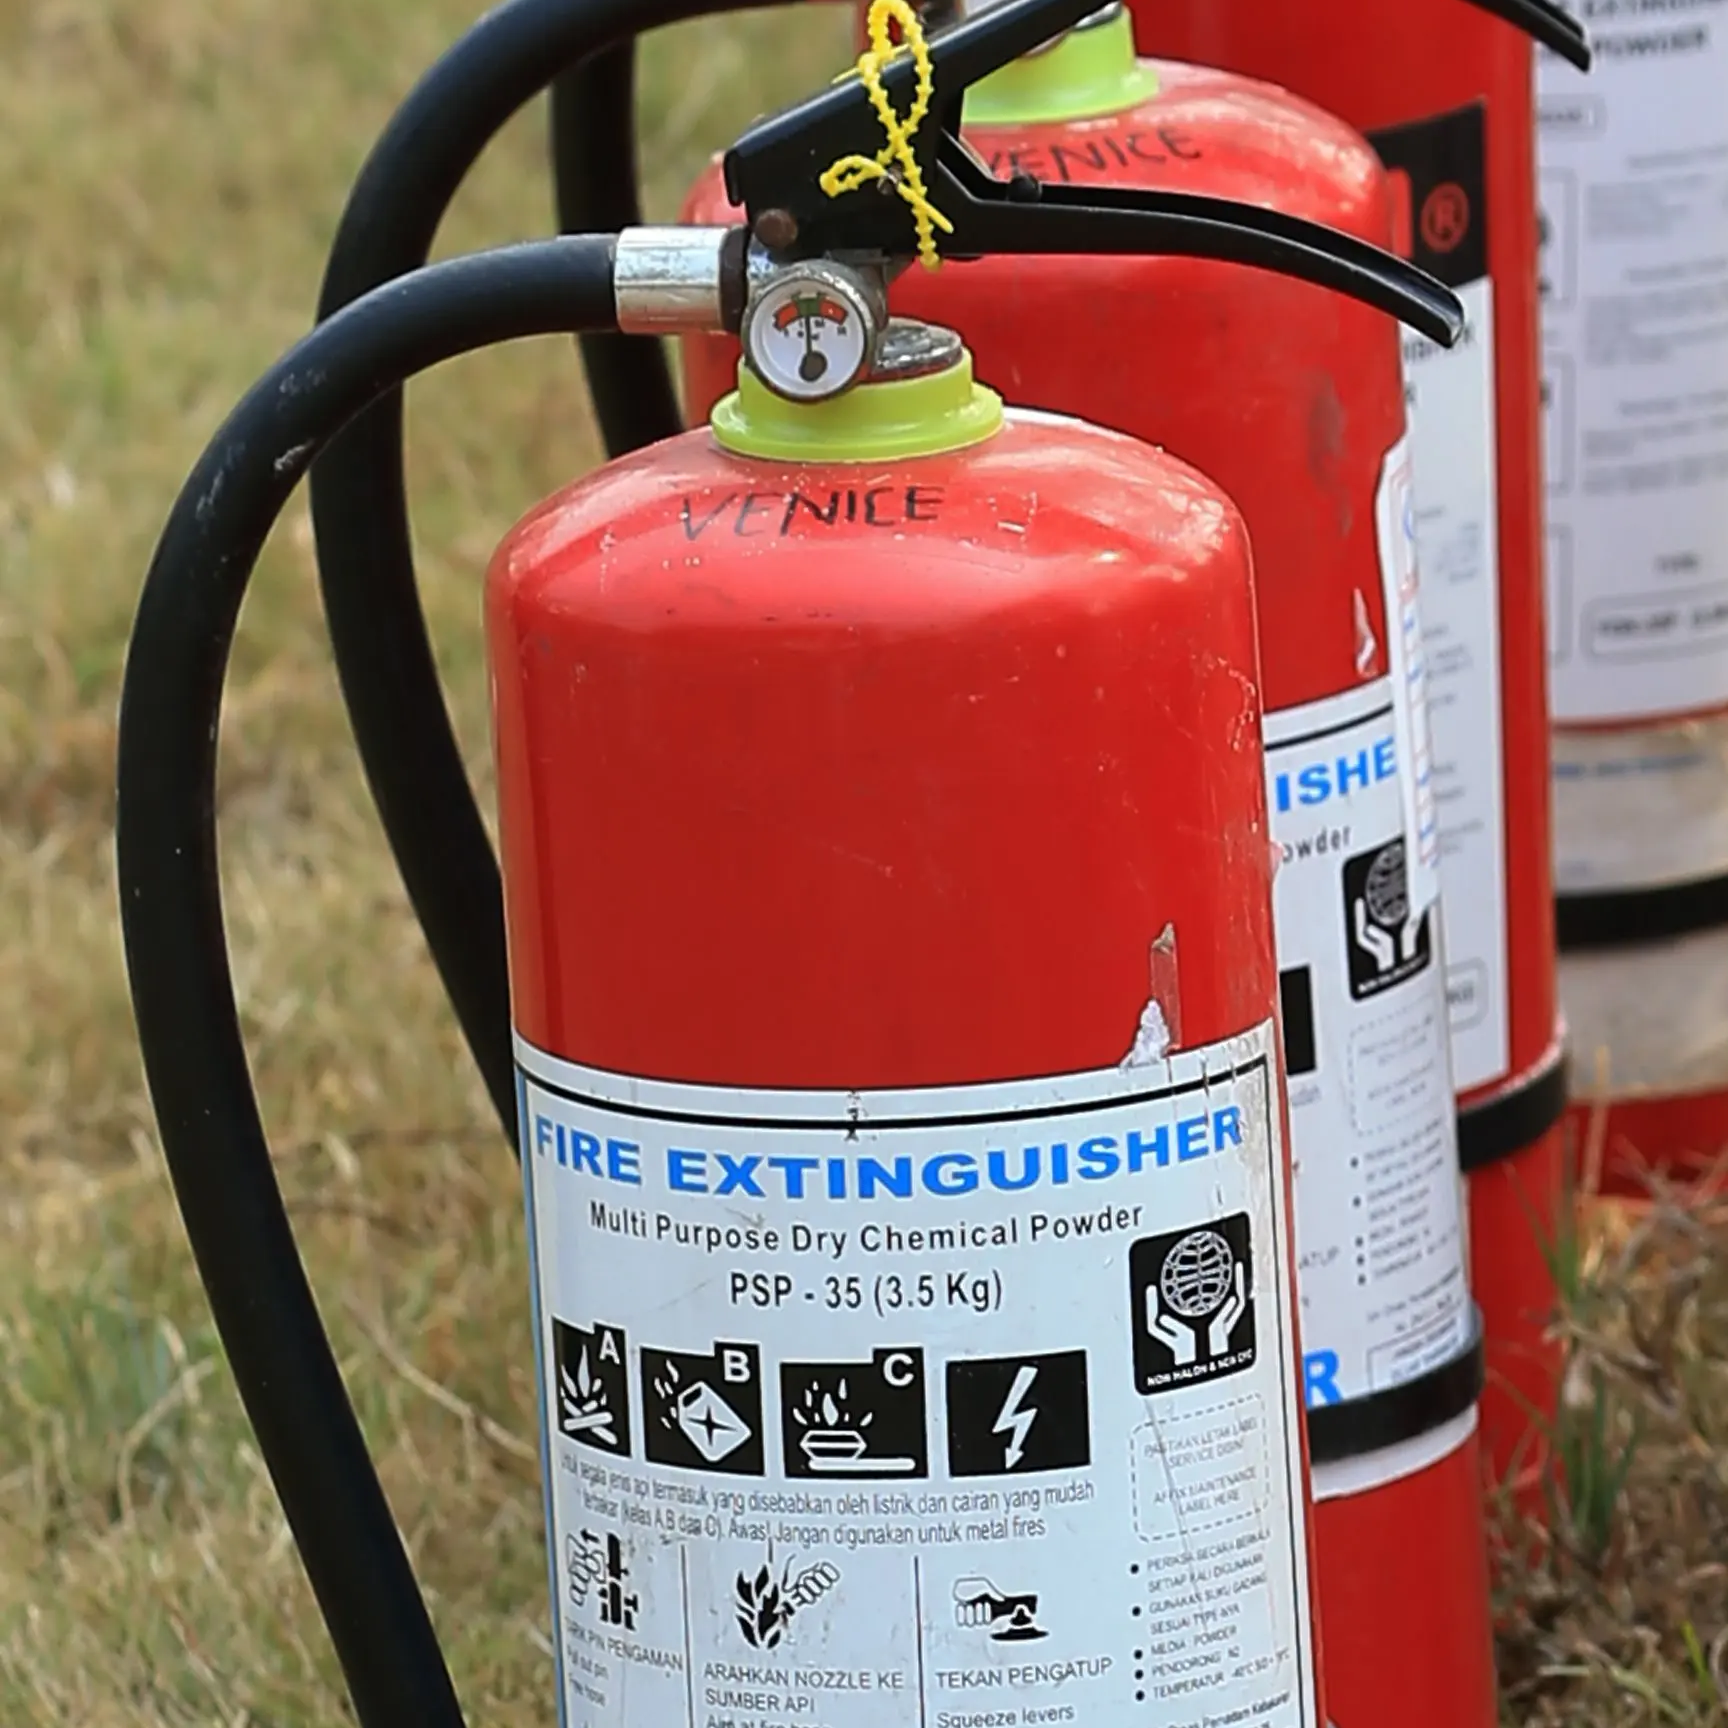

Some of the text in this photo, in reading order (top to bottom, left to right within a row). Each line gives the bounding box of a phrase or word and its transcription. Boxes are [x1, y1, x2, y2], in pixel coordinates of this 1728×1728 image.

[680, 486, 945, 541] VENICE
[1281, 825, 1351, 863] owder
[535, 1105, 1243, 1199] FIRE EXTINGUISHER
[590, 1200, 1143, 1259] Multi Purpose Dry Chemical Powder
[730, 1272, 793, 1308] PSP
[824, 1275, 862, 1310] 35
[874, 1272, 935, 1317] (3.5
[946, 1268, 1004, 1313] Kg)
[599, 1329, 621, 1365] A
[723, 1349, 751, 1382] B
[883, 1353, 915, 1387] C
[918, 1492, 948, 1514] dan
[606, 1636, 685, 1672] PENGAMAN
[702, 1662, 905, 1691] ARAHKAN NOZZLE KE
[935, 1656, 1114, 1690] TEKAN PENGATUP
[705, 1688, 815, 1714] SUMBER API
[1021, 1703, 1075, 1724] levers
